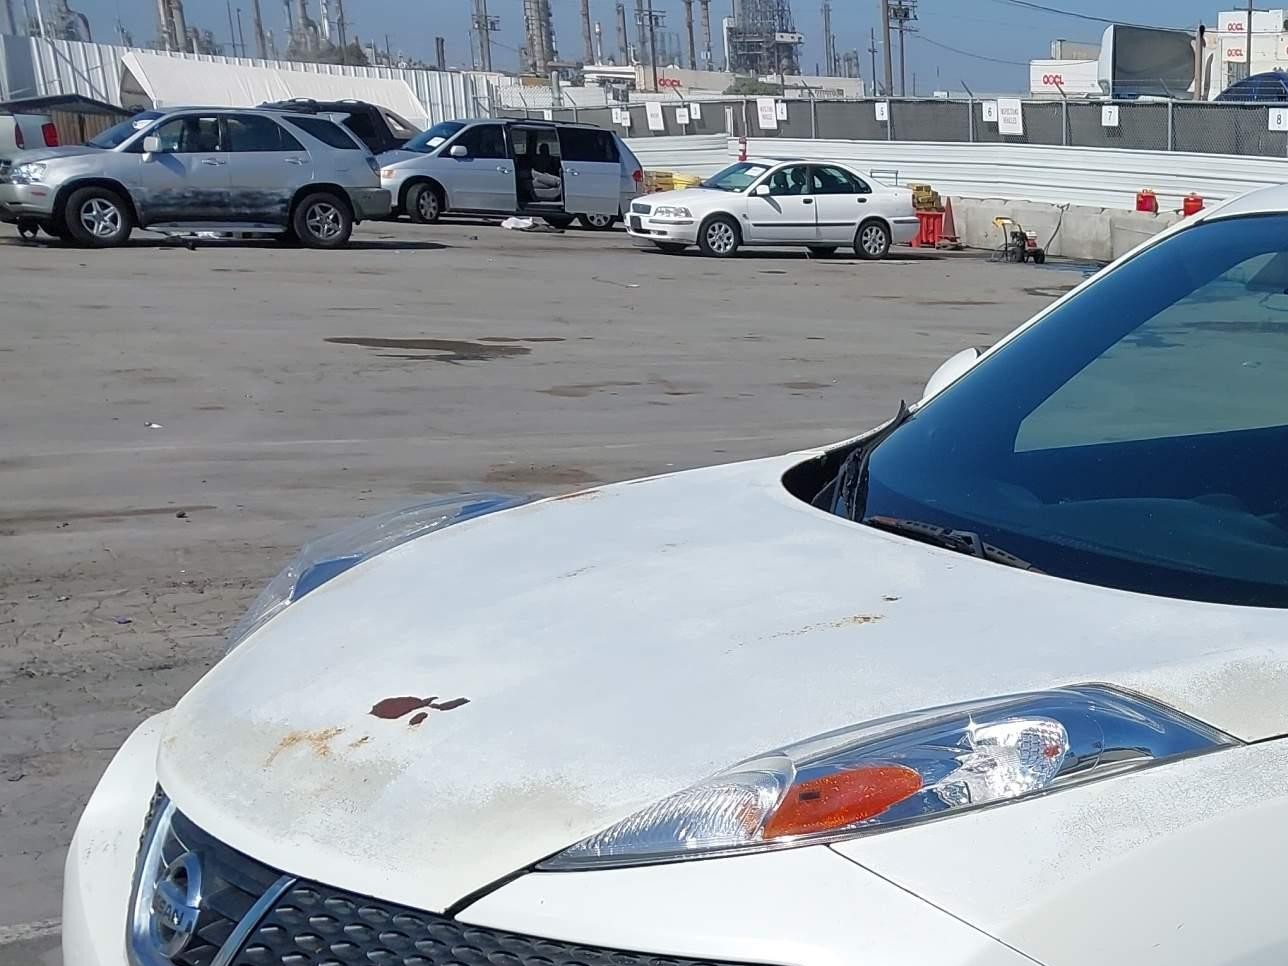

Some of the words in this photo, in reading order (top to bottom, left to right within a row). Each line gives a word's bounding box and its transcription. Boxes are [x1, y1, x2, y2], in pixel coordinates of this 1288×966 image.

[1228, 23, 1244, 31] OOCL
[1227, 48, 1243, 57] OOCL
[1043, 75, 1064, 85] OOCL
[988, 106, 993, 117] 6
[1108, 111, 1113, 121] 7
[1276, 114, 1282, 125] 8
